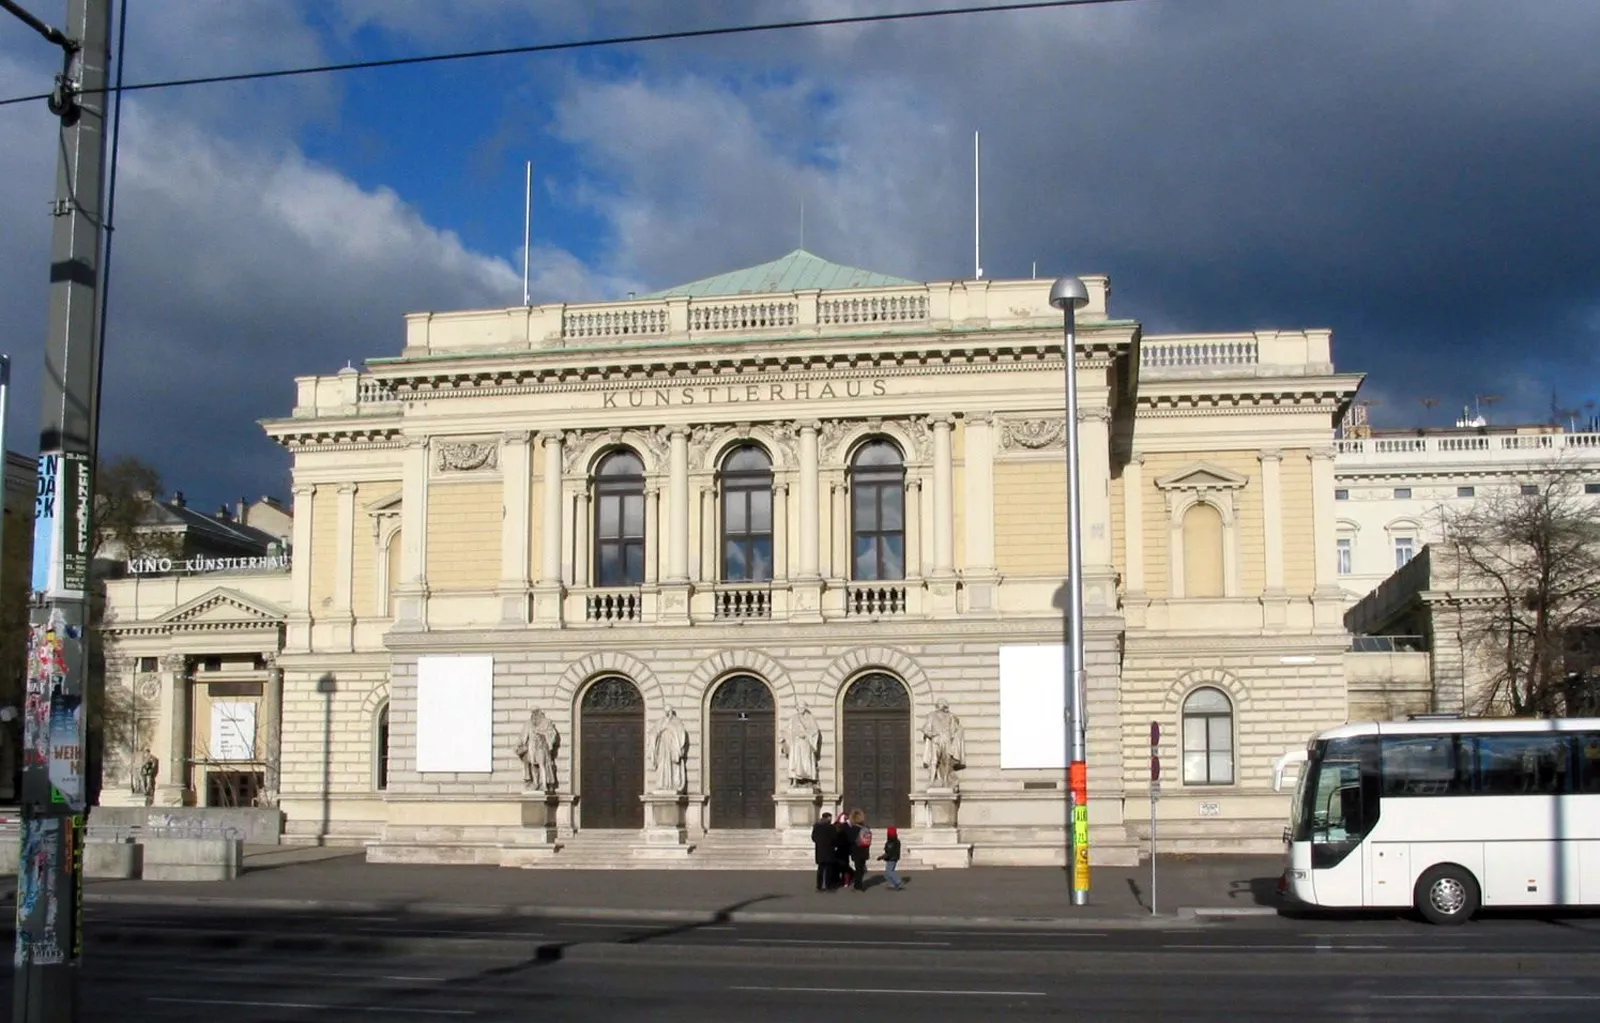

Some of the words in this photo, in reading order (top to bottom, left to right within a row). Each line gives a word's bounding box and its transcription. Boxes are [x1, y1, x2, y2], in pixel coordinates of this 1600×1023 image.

[602, 379, 888, 408] KÜNSTLERHAUS
[127, 558, 172, 574] KINO
[186, 554, 292, 572] KÜNSTLERHAU
